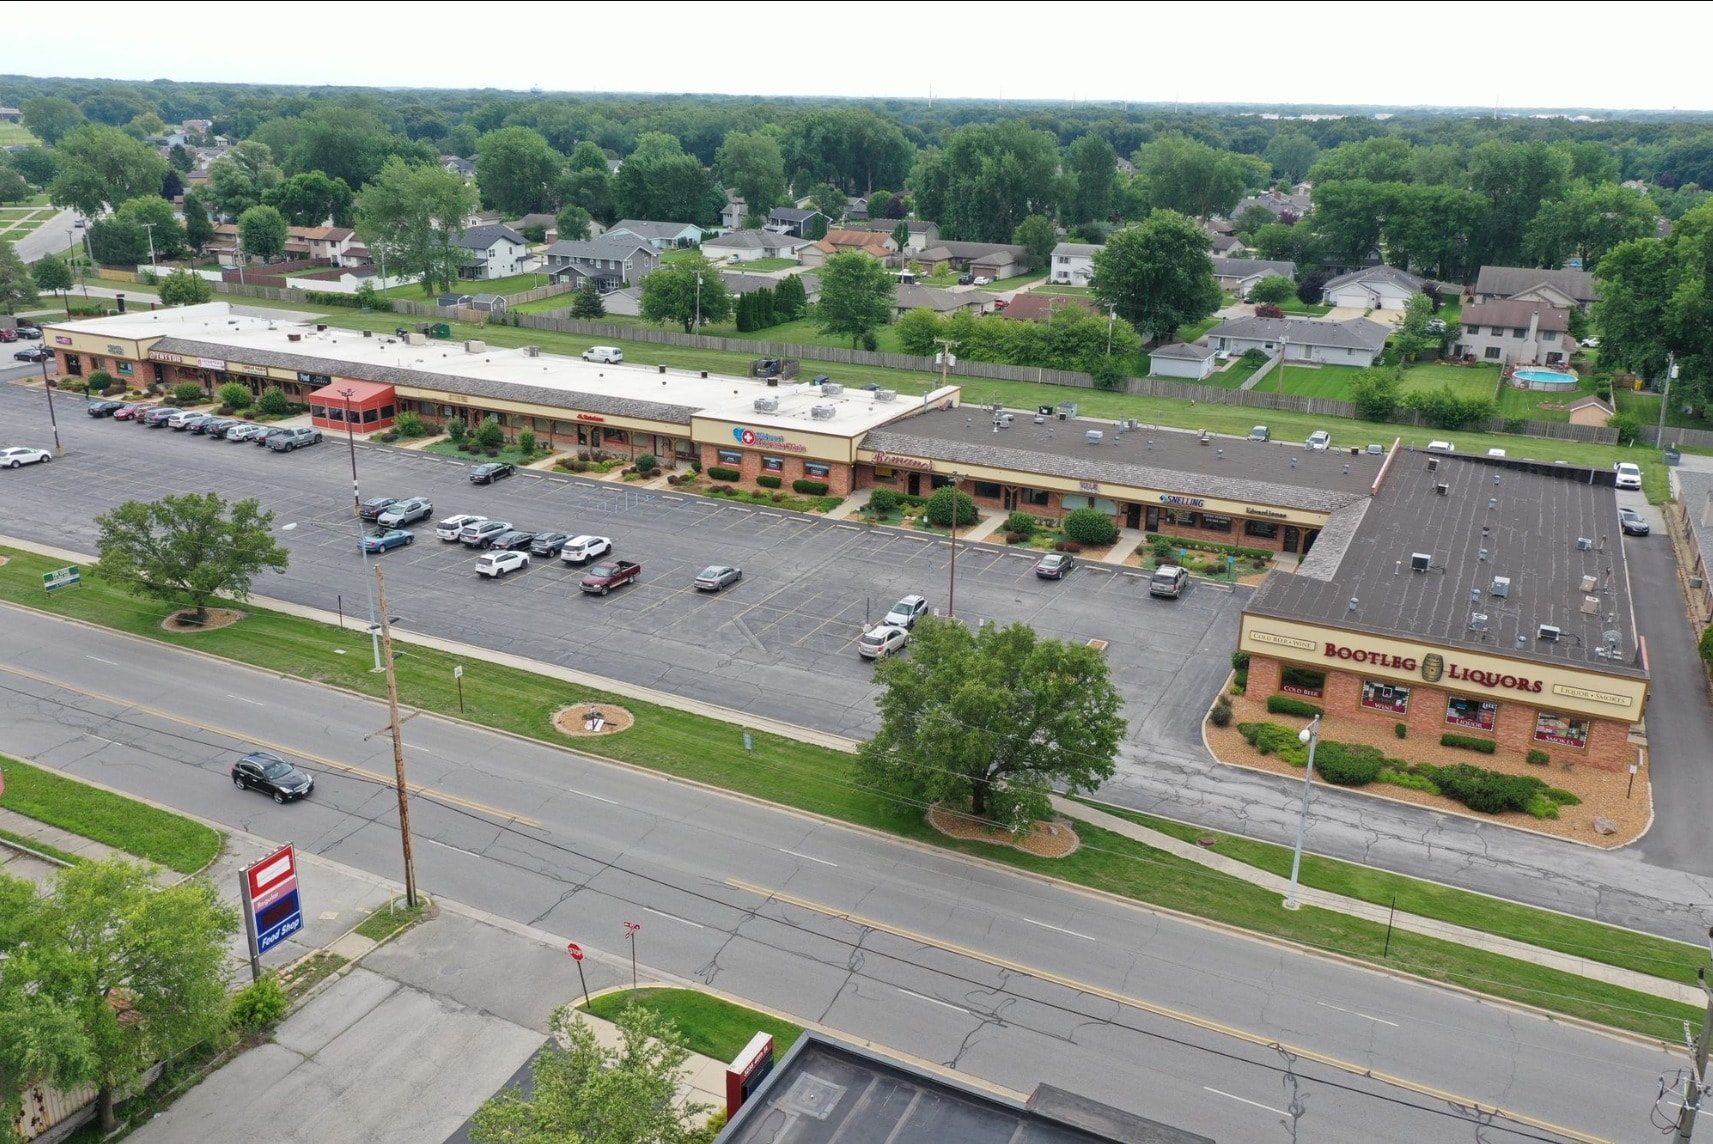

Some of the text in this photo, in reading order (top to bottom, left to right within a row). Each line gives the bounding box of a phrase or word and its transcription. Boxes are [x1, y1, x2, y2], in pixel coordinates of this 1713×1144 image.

[1167, 495, 1204, 508] SNELLING
[1253, 633, 1312, 648] COLD BEER WINE
[1323, 642, 1544, 694] BOOTLEG LIQUORS
[1283, 685, 1319, 697] COLD BEER
[1560, 687, 1625, 704] LIQUOR SMOKES
[1374, 702, 1393, 711] WINE
[1456, 718, 1482, 729] LIQUOR
[1545, 735, 1574, 745] SMOKES
[261, 918, 300, 949] Food Shop
[568, 947, 582, 956] STOP
